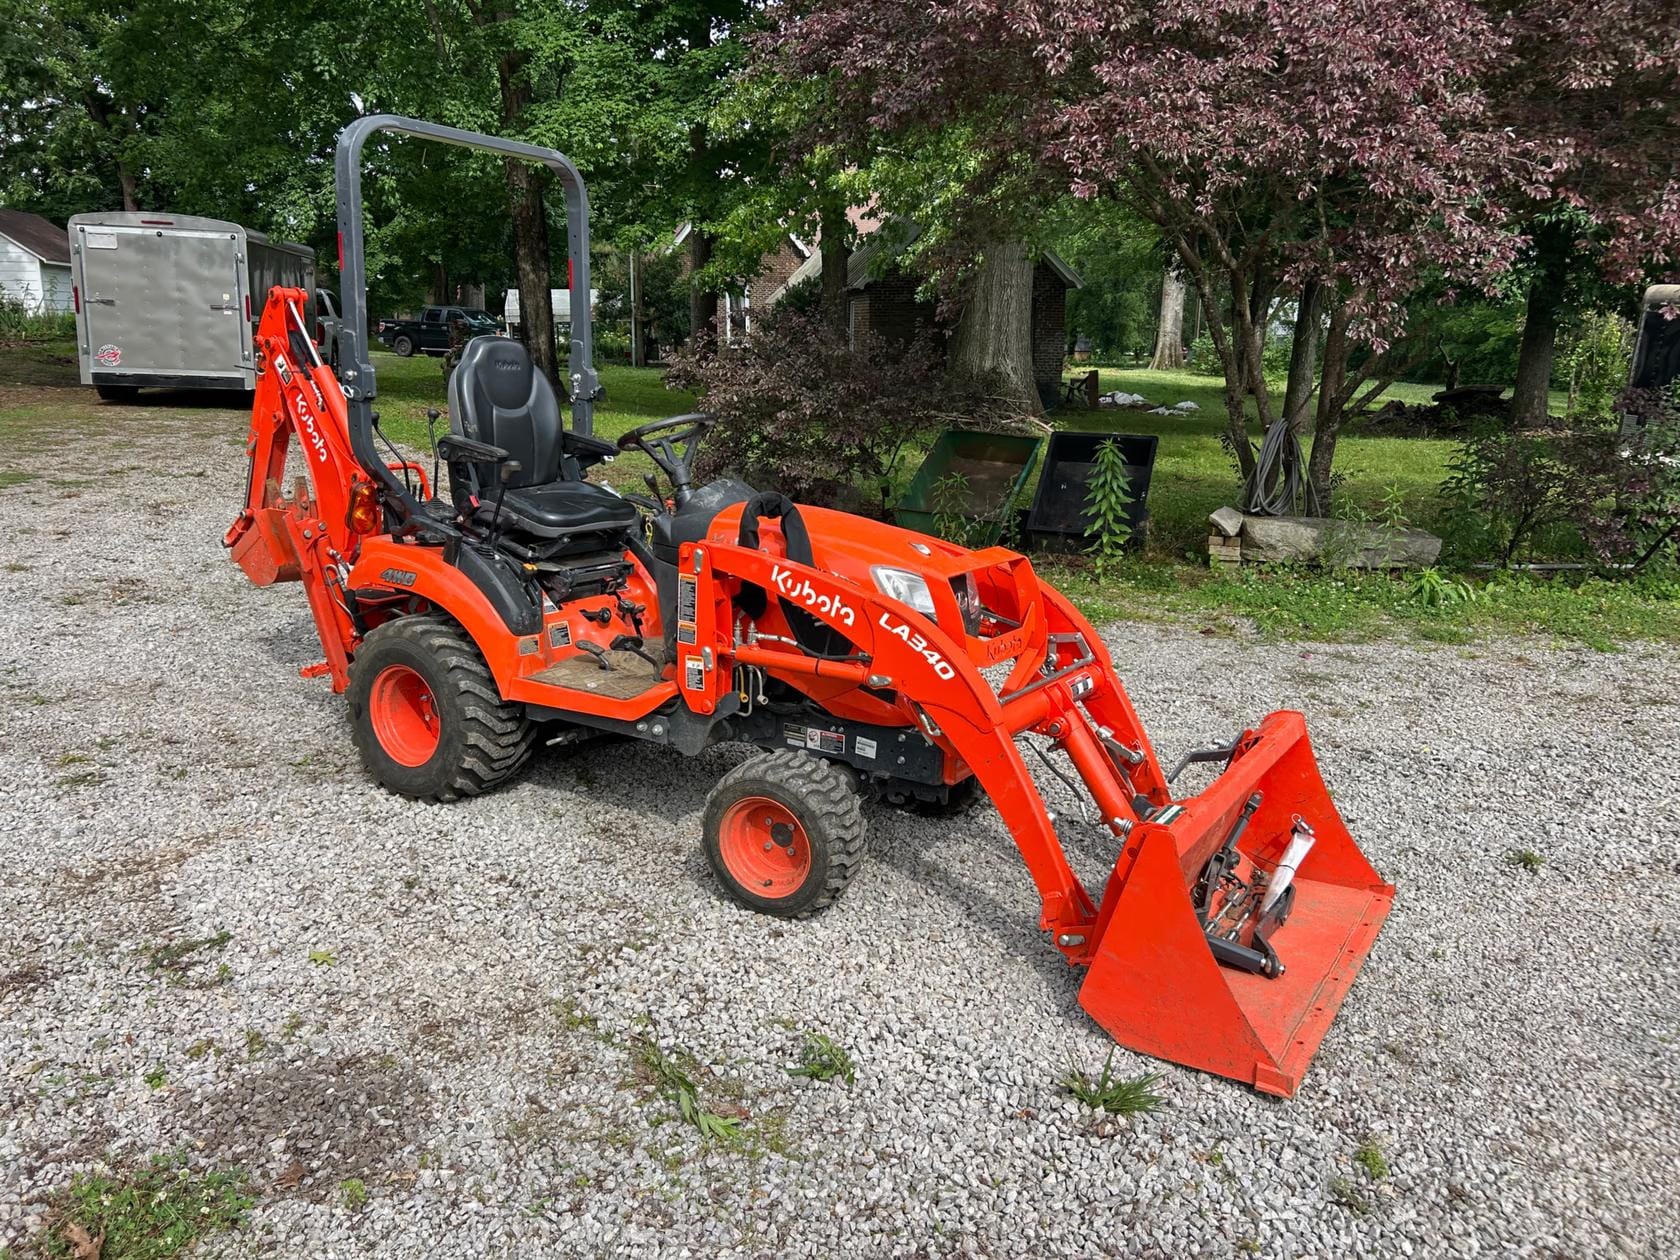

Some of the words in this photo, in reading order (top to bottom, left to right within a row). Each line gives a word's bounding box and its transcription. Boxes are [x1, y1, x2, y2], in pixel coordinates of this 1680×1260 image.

[296, 393, 327, 462] Kubota
[380, 567, 417, 587] 4WD
[770, 564, 855, 627] Kubota
[878, 611, 955, 681] LA340
